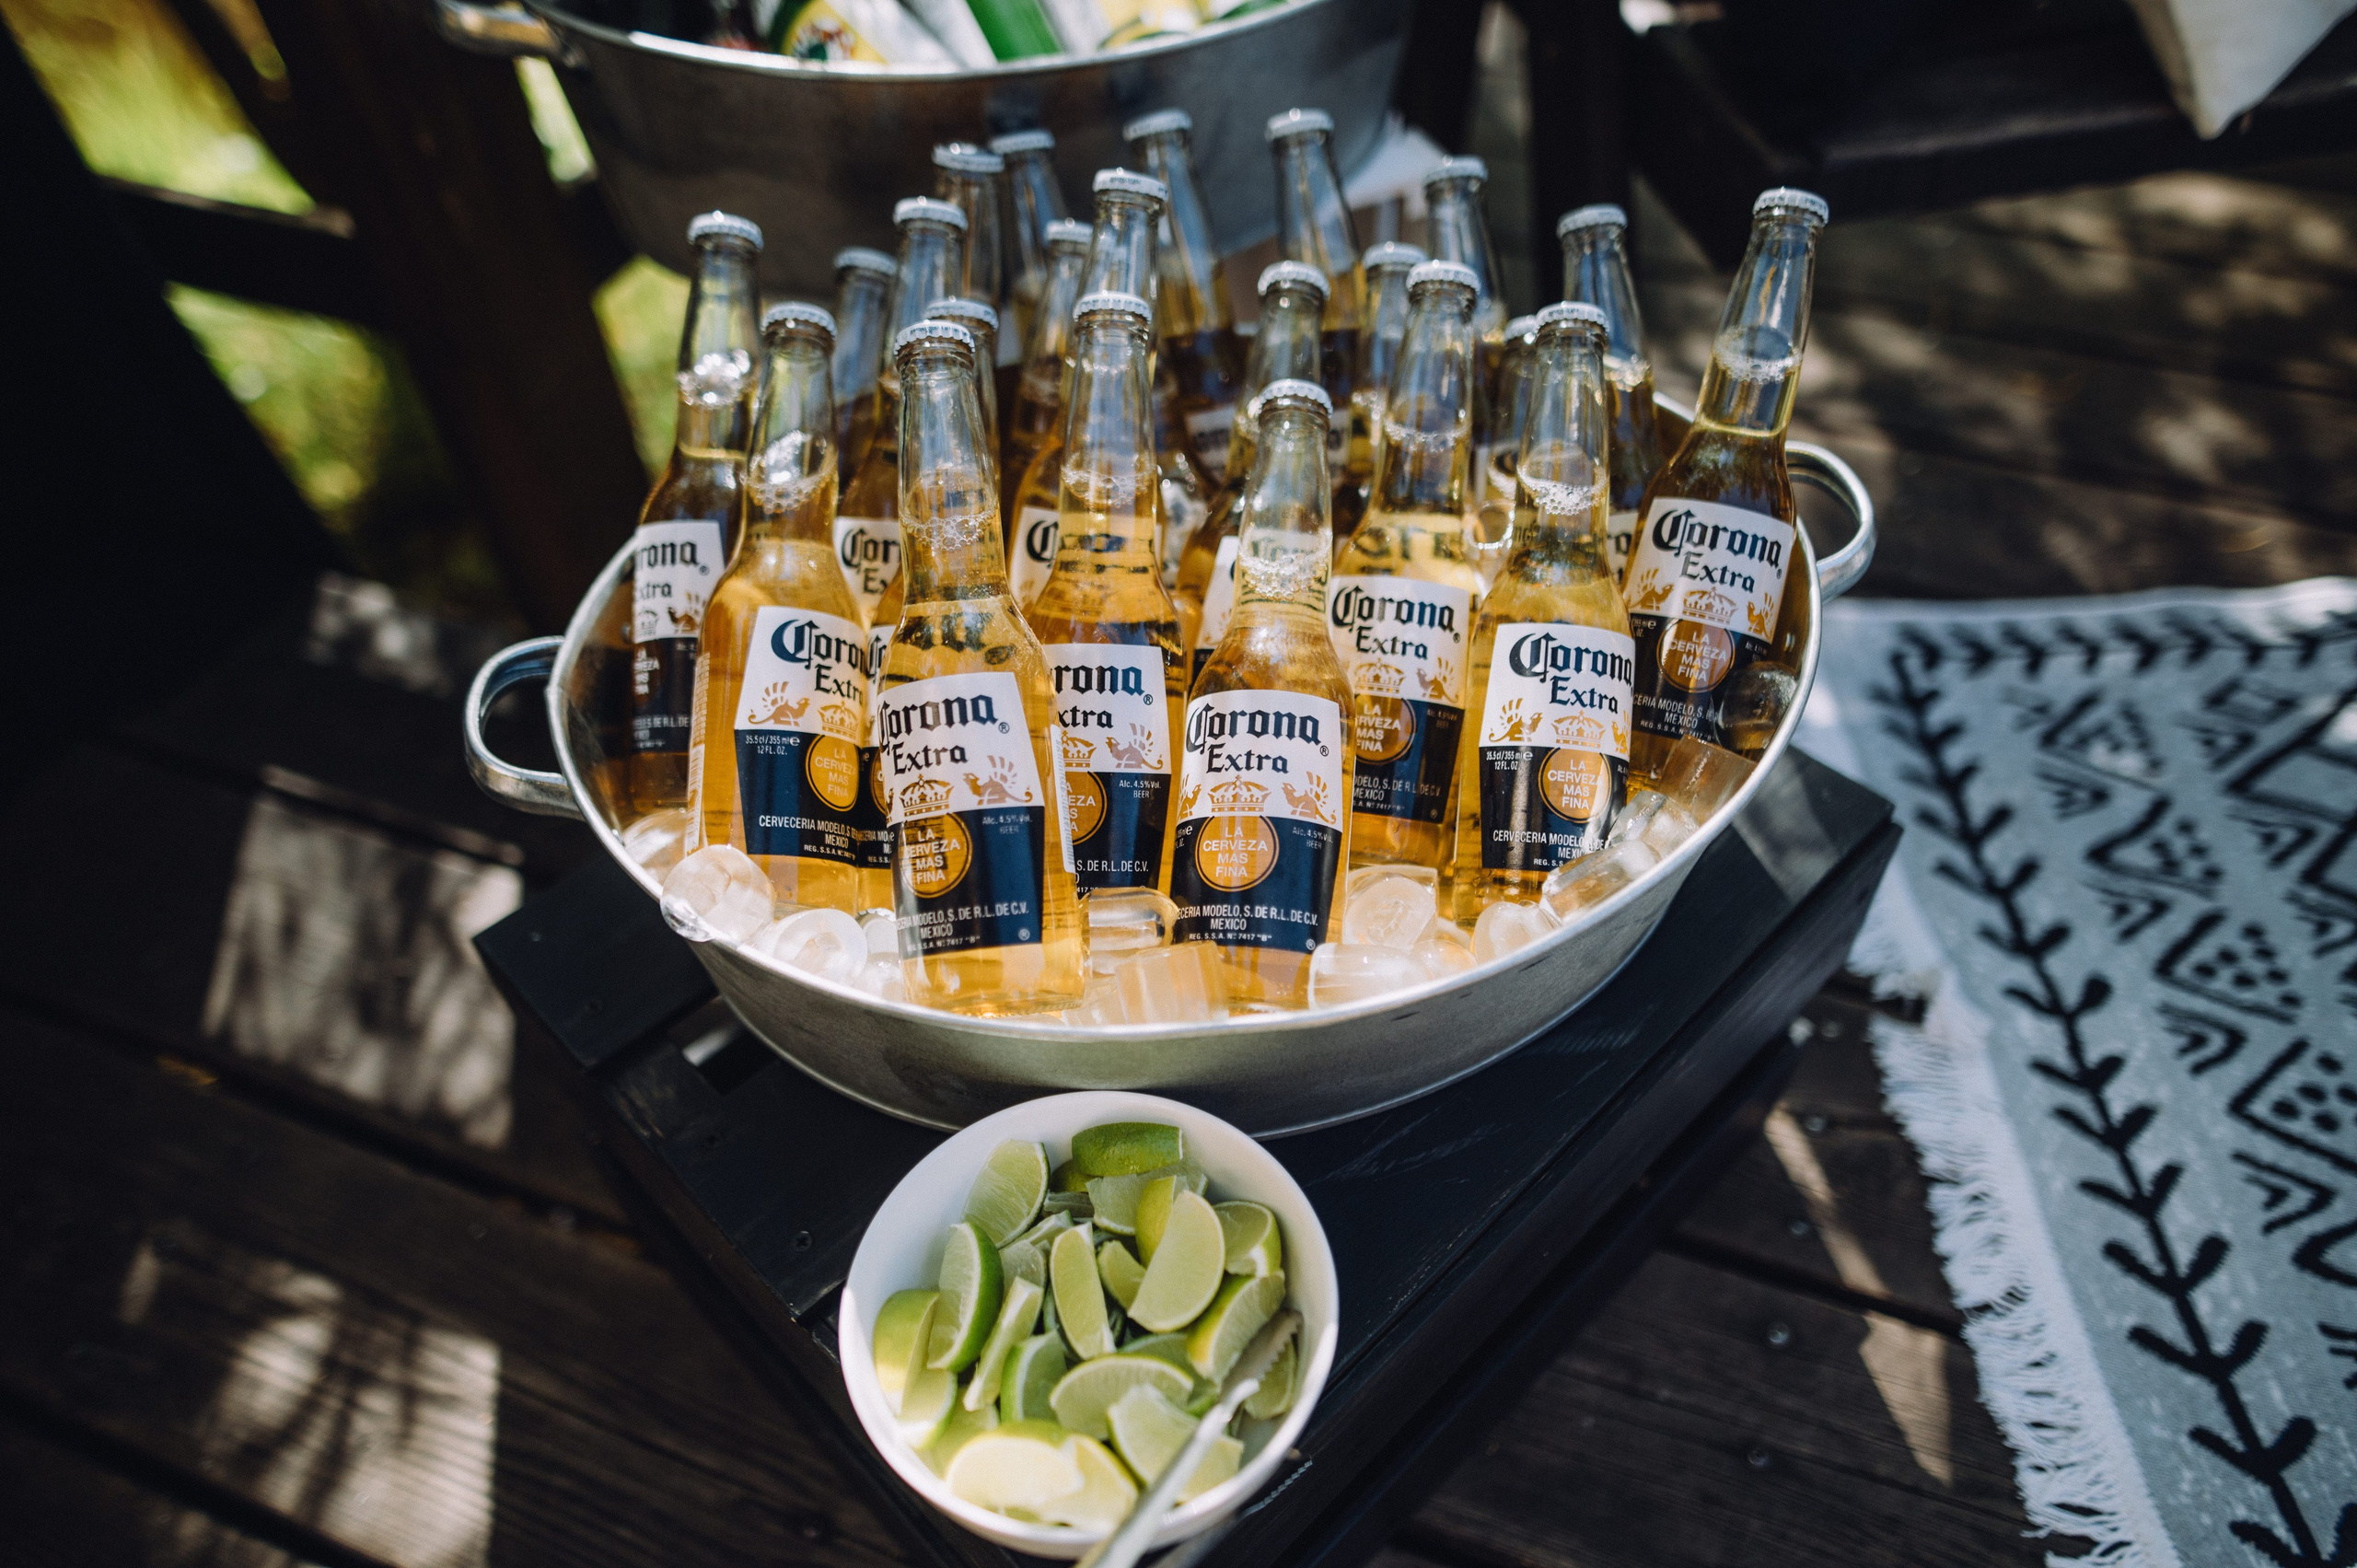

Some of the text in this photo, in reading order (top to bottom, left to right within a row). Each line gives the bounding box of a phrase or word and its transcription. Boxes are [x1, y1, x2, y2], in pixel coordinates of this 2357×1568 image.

[1652, 508, 1782, 569] Corona
[639, 541, 699, 567] rona
[842, 528, 900, 574] Cor
[1679, 551, 1756, 594] Extra
[639, 583, 672, 599] xtra
[1331, 585, 1455, 633] Corona
[1356, 625, 1428, 660] Extra
[1692, 631, 1710, 645] LA
[771, 619, 866, 673] Coron
[1669, 639, 1727, 662] CERVEZA
[1509, 632, 1632, 687] Corona
[1681, 654, 1710, 669] MAS
[1054, 664, 1144, 696] rona
[1678, 666, 1707, 681] FINA
[1549, 675, 1619, 714] Extra
[1633, 694, 1655, 708] CERIA
[1059, 703, 1113, 729] xtra
[1364, 703, 1381, 715] LA
[877, 693, 998, 755] Corona
[1357, 715, 1401, 731] RVEZA
[1641, 720, 1655, 729] REG.
[1665, 712, 1698, 729] MEXICO
[1186, 703, 1321, 754] Corona
[1356, 727, 1384, 740] MAS
[833, 748, 846, 761] LA
[891, 741, 968, 775] Extra
[1206, 743, 1289, 773] Extra
[1570, 760, 1586, 771] LA
[829, 772, 849, 786] MAS
[1120, 780, 1132, 788] Alc.
[1354, 775, 1381, 790] DELO,
[1392, 780, 1402, 792] DE
[828, 784, 849, 798] FINA
[1133, 790, 1150, 798] BEER
[1353, 787, 1385, 801] MEXICO
[1563, 784, 1590, 797] MAS
[1562, 798, 1589, 810] FINA
[759, 815, 816, 830] CERVECERIA
[918, 829, 935, 842] LA
[1225, 827, 1243, 838] LA
[1493, 830, 1547, 844] CERVECERIA
[825, 833, 849, 849] MEXICO
[905, 839, 960, 858] CERVEZA
[1202, 840, 1268, 852] CERVEZA
[1306, 840, 1322, 850] BEER
[1217, 853, 1248, 864] MAS
[1558, 847, 1585, 859] MEXI
[915, 854, 944, 870] MAS
[1087, 860, 1099, 872] DE
[1101, 860, 1120, 872] R.L.
[1121, 860, 1133, 872] DE
[1134, 860, 1149, 872] C.V.
[917, 869, 946, 884] FINA
[1215, 866, 1248, 877] FINA
[958, 908, 972, 921] DE
[974, 904, 994, 919] R.L.
[995, 902, 1009, 916] DE
[1011, 901, 1028, 915] C.V.
[1178, 905, 1200, 920] ECERIA
[1202, 904, 1242, 918] MODELO,
[1255, 905, 1268, 918] DE
[1270, 907, 1289, 921] R.L.
[1291, 910, 1302, 923] DE
[1304, 912, 1318, 926] C.V.
[921, 923, 953, 939] MEXICO
[1211, 918, 1247, 931] MEXICO
[1238, 933, 1255, 941] 7417
